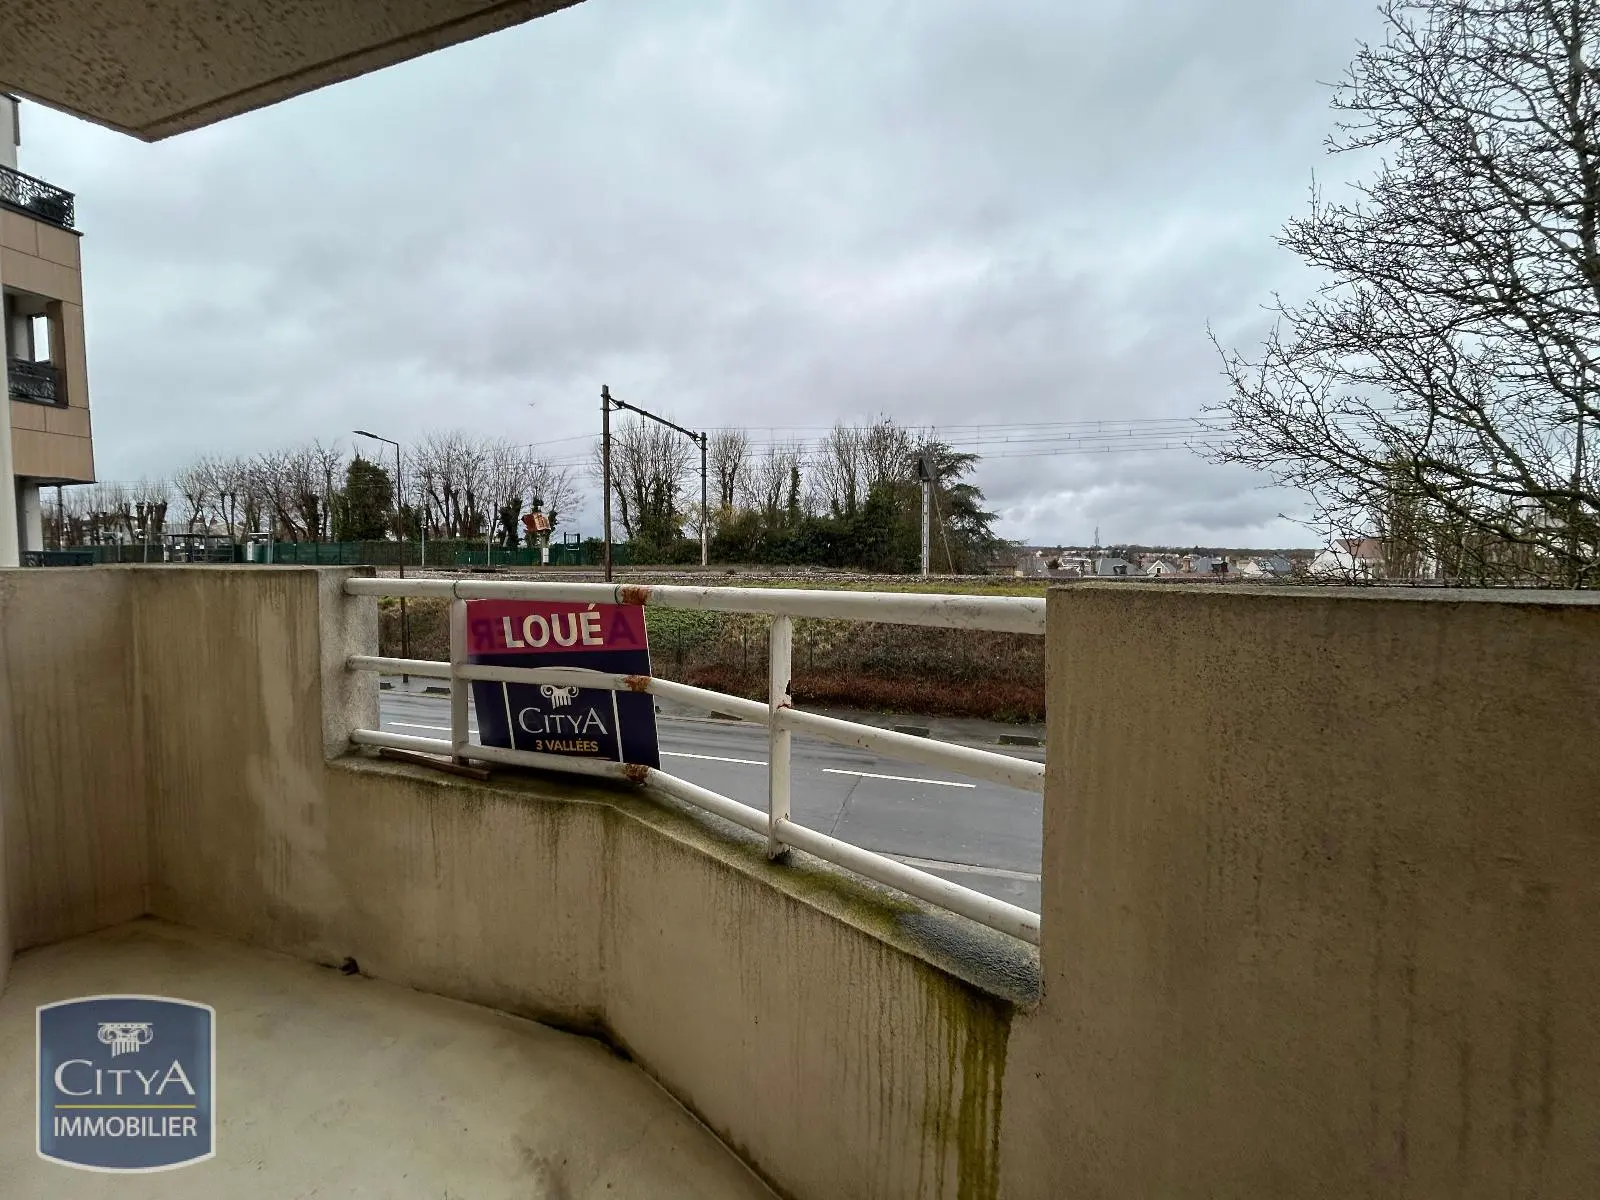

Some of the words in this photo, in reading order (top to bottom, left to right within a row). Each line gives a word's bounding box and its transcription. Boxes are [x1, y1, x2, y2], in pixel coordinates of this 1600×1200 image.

[503, 604, 603, 648] LOUÉ
[518, 707, 608, 735] CITYA
[536, 740, 543, 751] 3
[547, 738, 599, 752] VALLÉES
